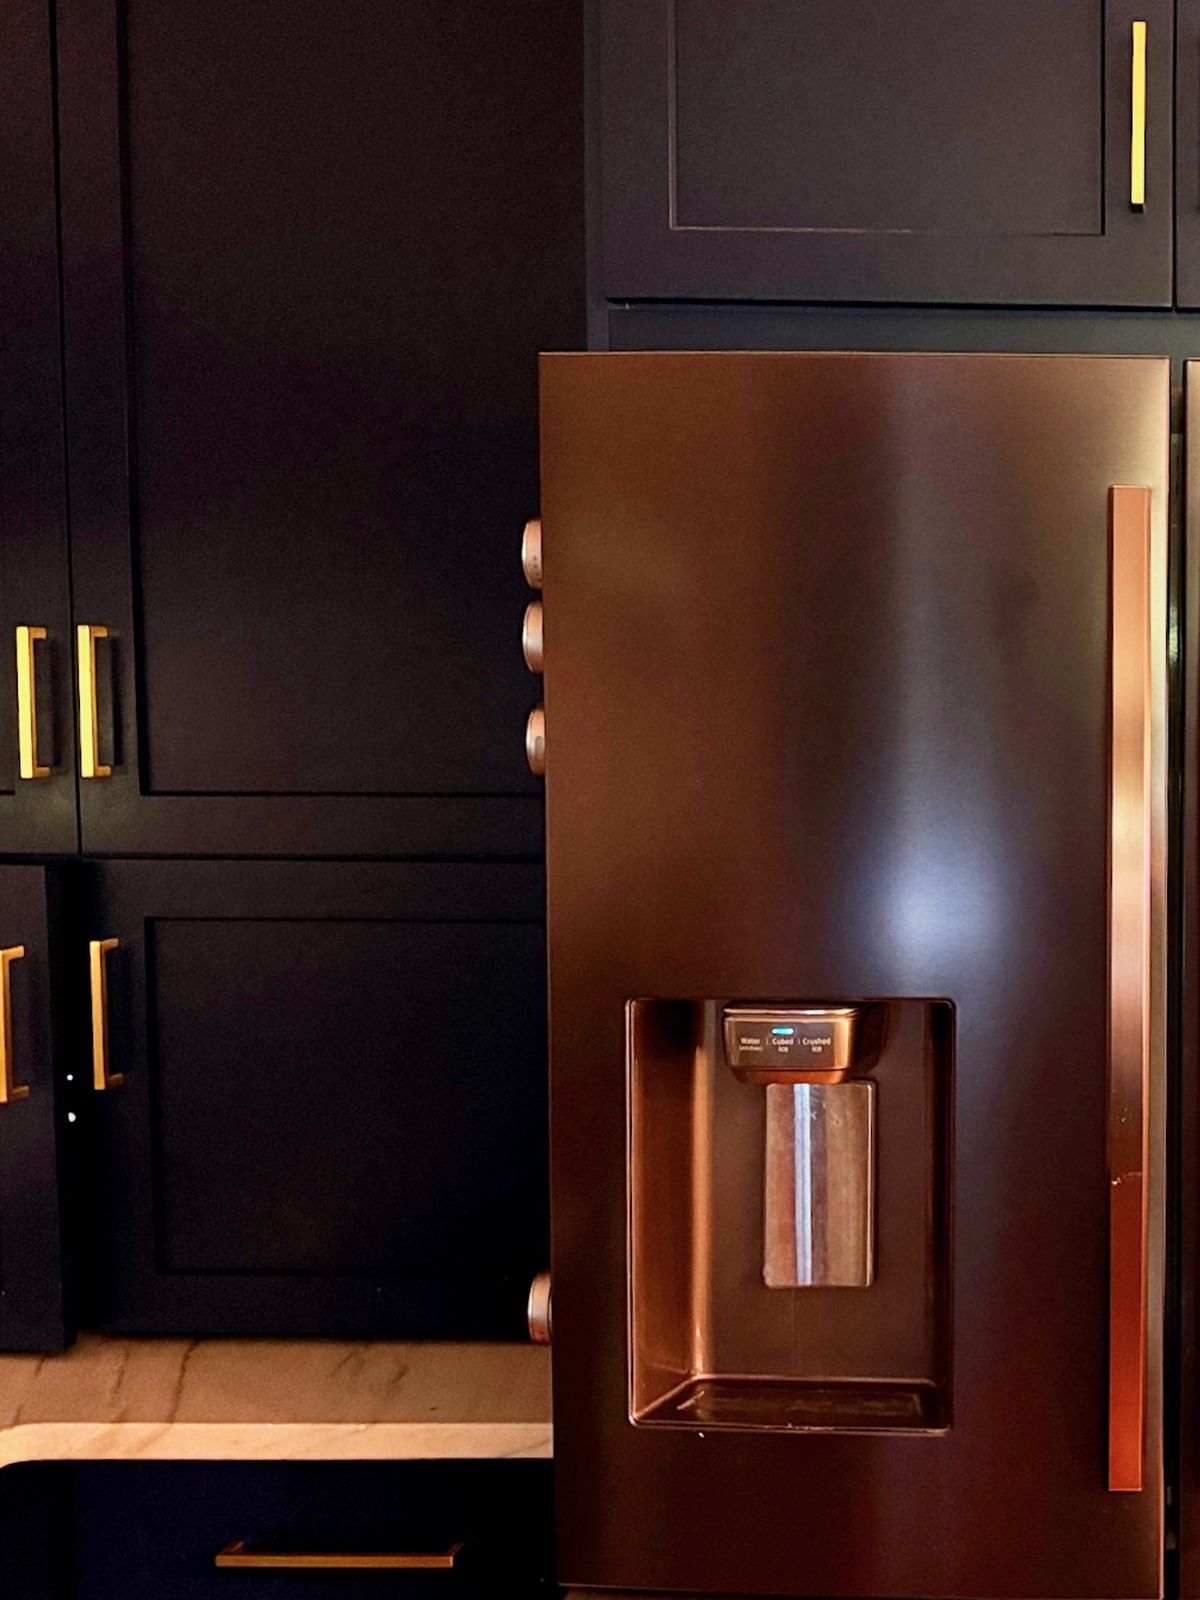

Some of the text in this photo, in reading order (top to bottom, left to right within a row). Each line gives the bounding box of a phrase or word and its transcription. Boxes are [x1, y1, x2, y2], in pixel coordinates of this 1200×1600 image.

[741, 1037, 760, 1045] Water
[772, 1037, 794, 1045] Cubed
[802, 1037, 830, 1045] Crushed
